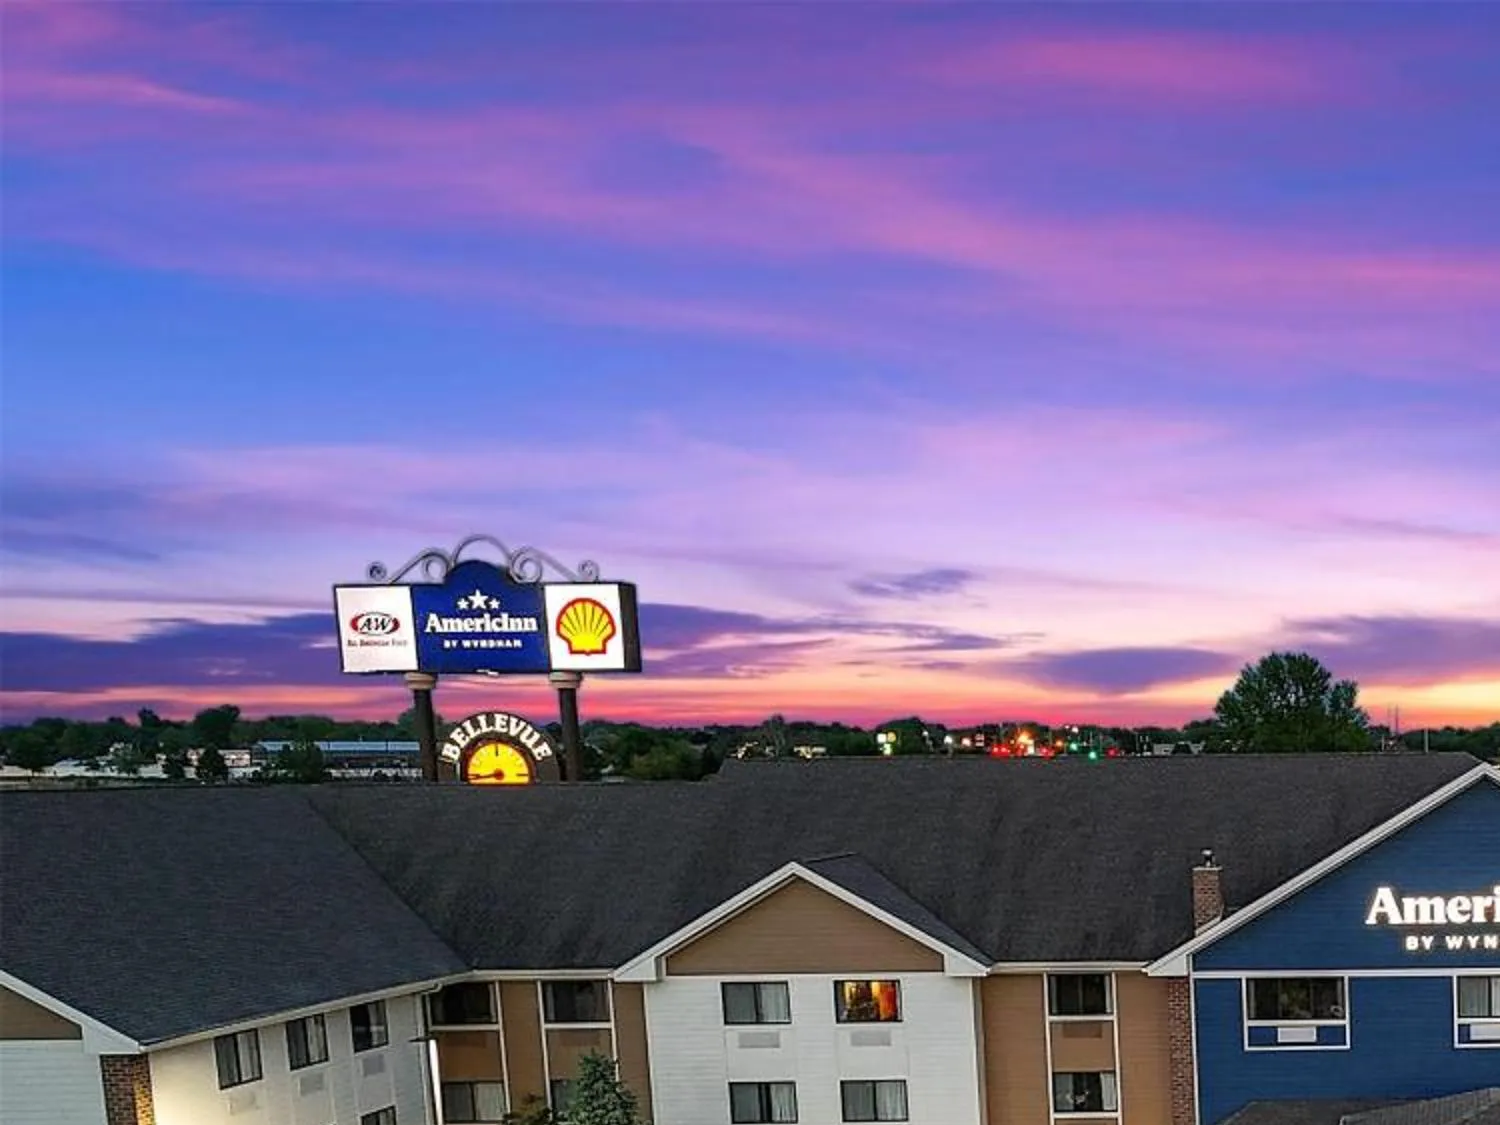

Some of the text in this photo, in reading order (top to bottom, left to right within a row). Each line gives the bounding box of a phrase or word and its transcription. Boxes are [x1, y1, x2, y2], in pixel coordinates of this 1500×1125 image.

[424, 613, 539, 632] AmericInn
[443, 639, 523, 649] BY WYNDHAM
[441, 713, 553, 761] BELLEVUE
[1405, 935, 1434, 950] BY
